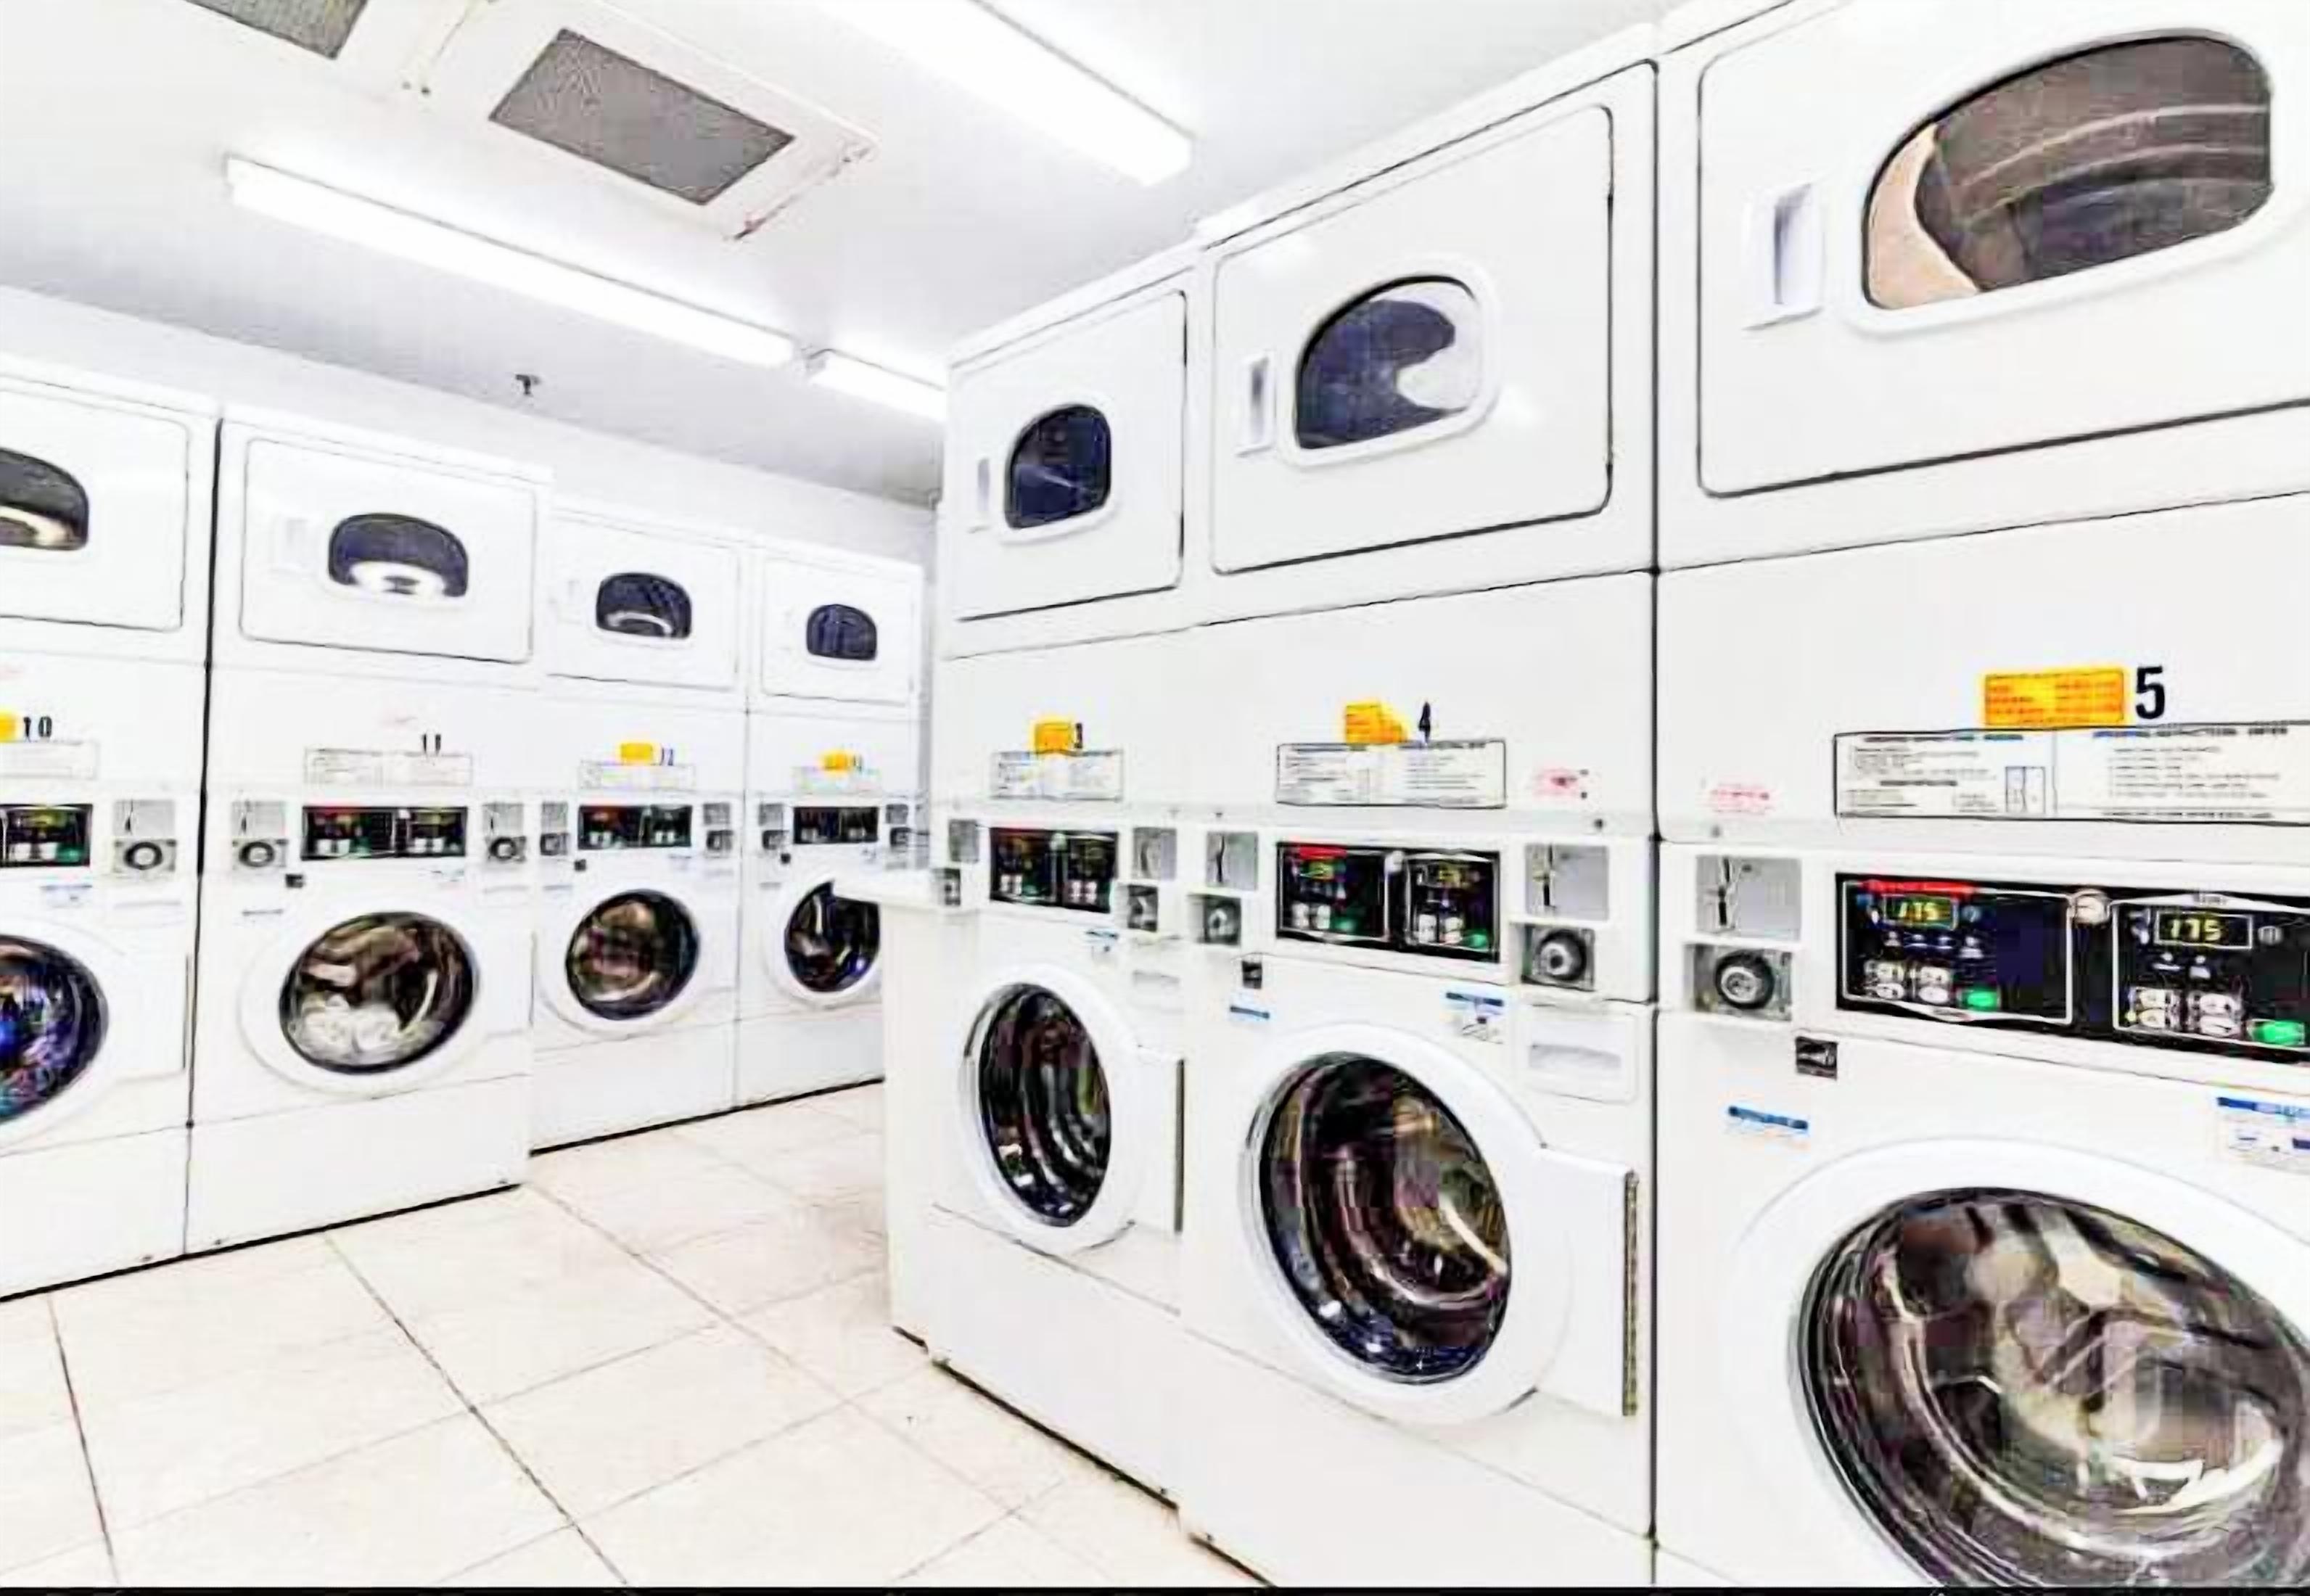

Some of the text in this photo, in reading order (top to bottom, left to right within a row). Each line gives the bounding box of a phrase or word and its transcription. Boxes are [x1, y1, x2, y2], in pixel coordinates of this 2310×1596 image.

[2136, 665, 2165, 720] 5
[23, 716, 52, 738] 10
[1418, 702, 1431, 743] 4
[422, 733, 441, 754] 11
